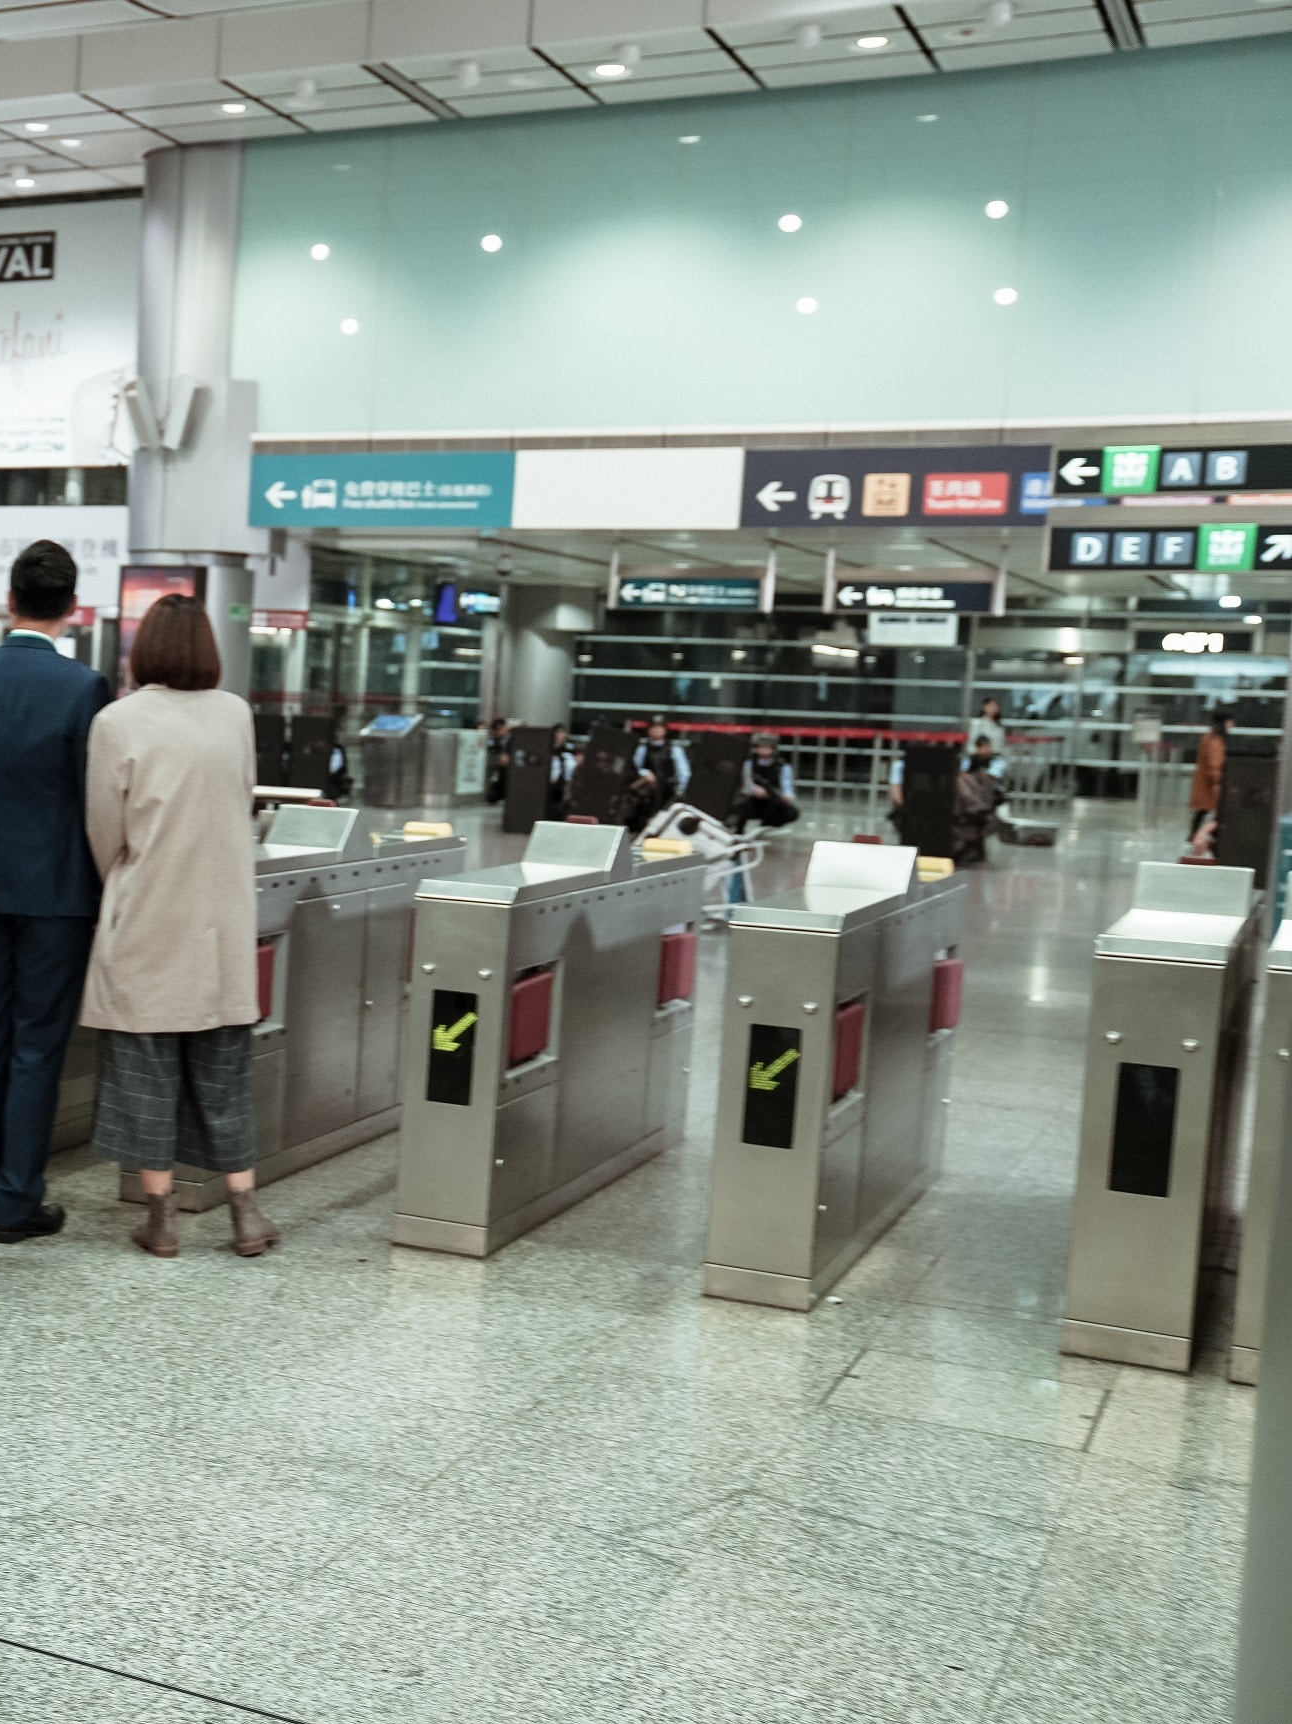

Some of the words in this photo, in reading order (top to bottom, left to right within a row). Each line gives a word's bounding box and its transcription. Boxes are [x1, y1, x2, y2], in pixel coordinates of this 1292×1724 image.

[1168, 457, 1194, 481] A
[1214, 455, 1239, 480] B
[1075, 536, 1103, 561] D
[1120, 536, 1142, 561] E
[1162, 536, 1185, 561] F
